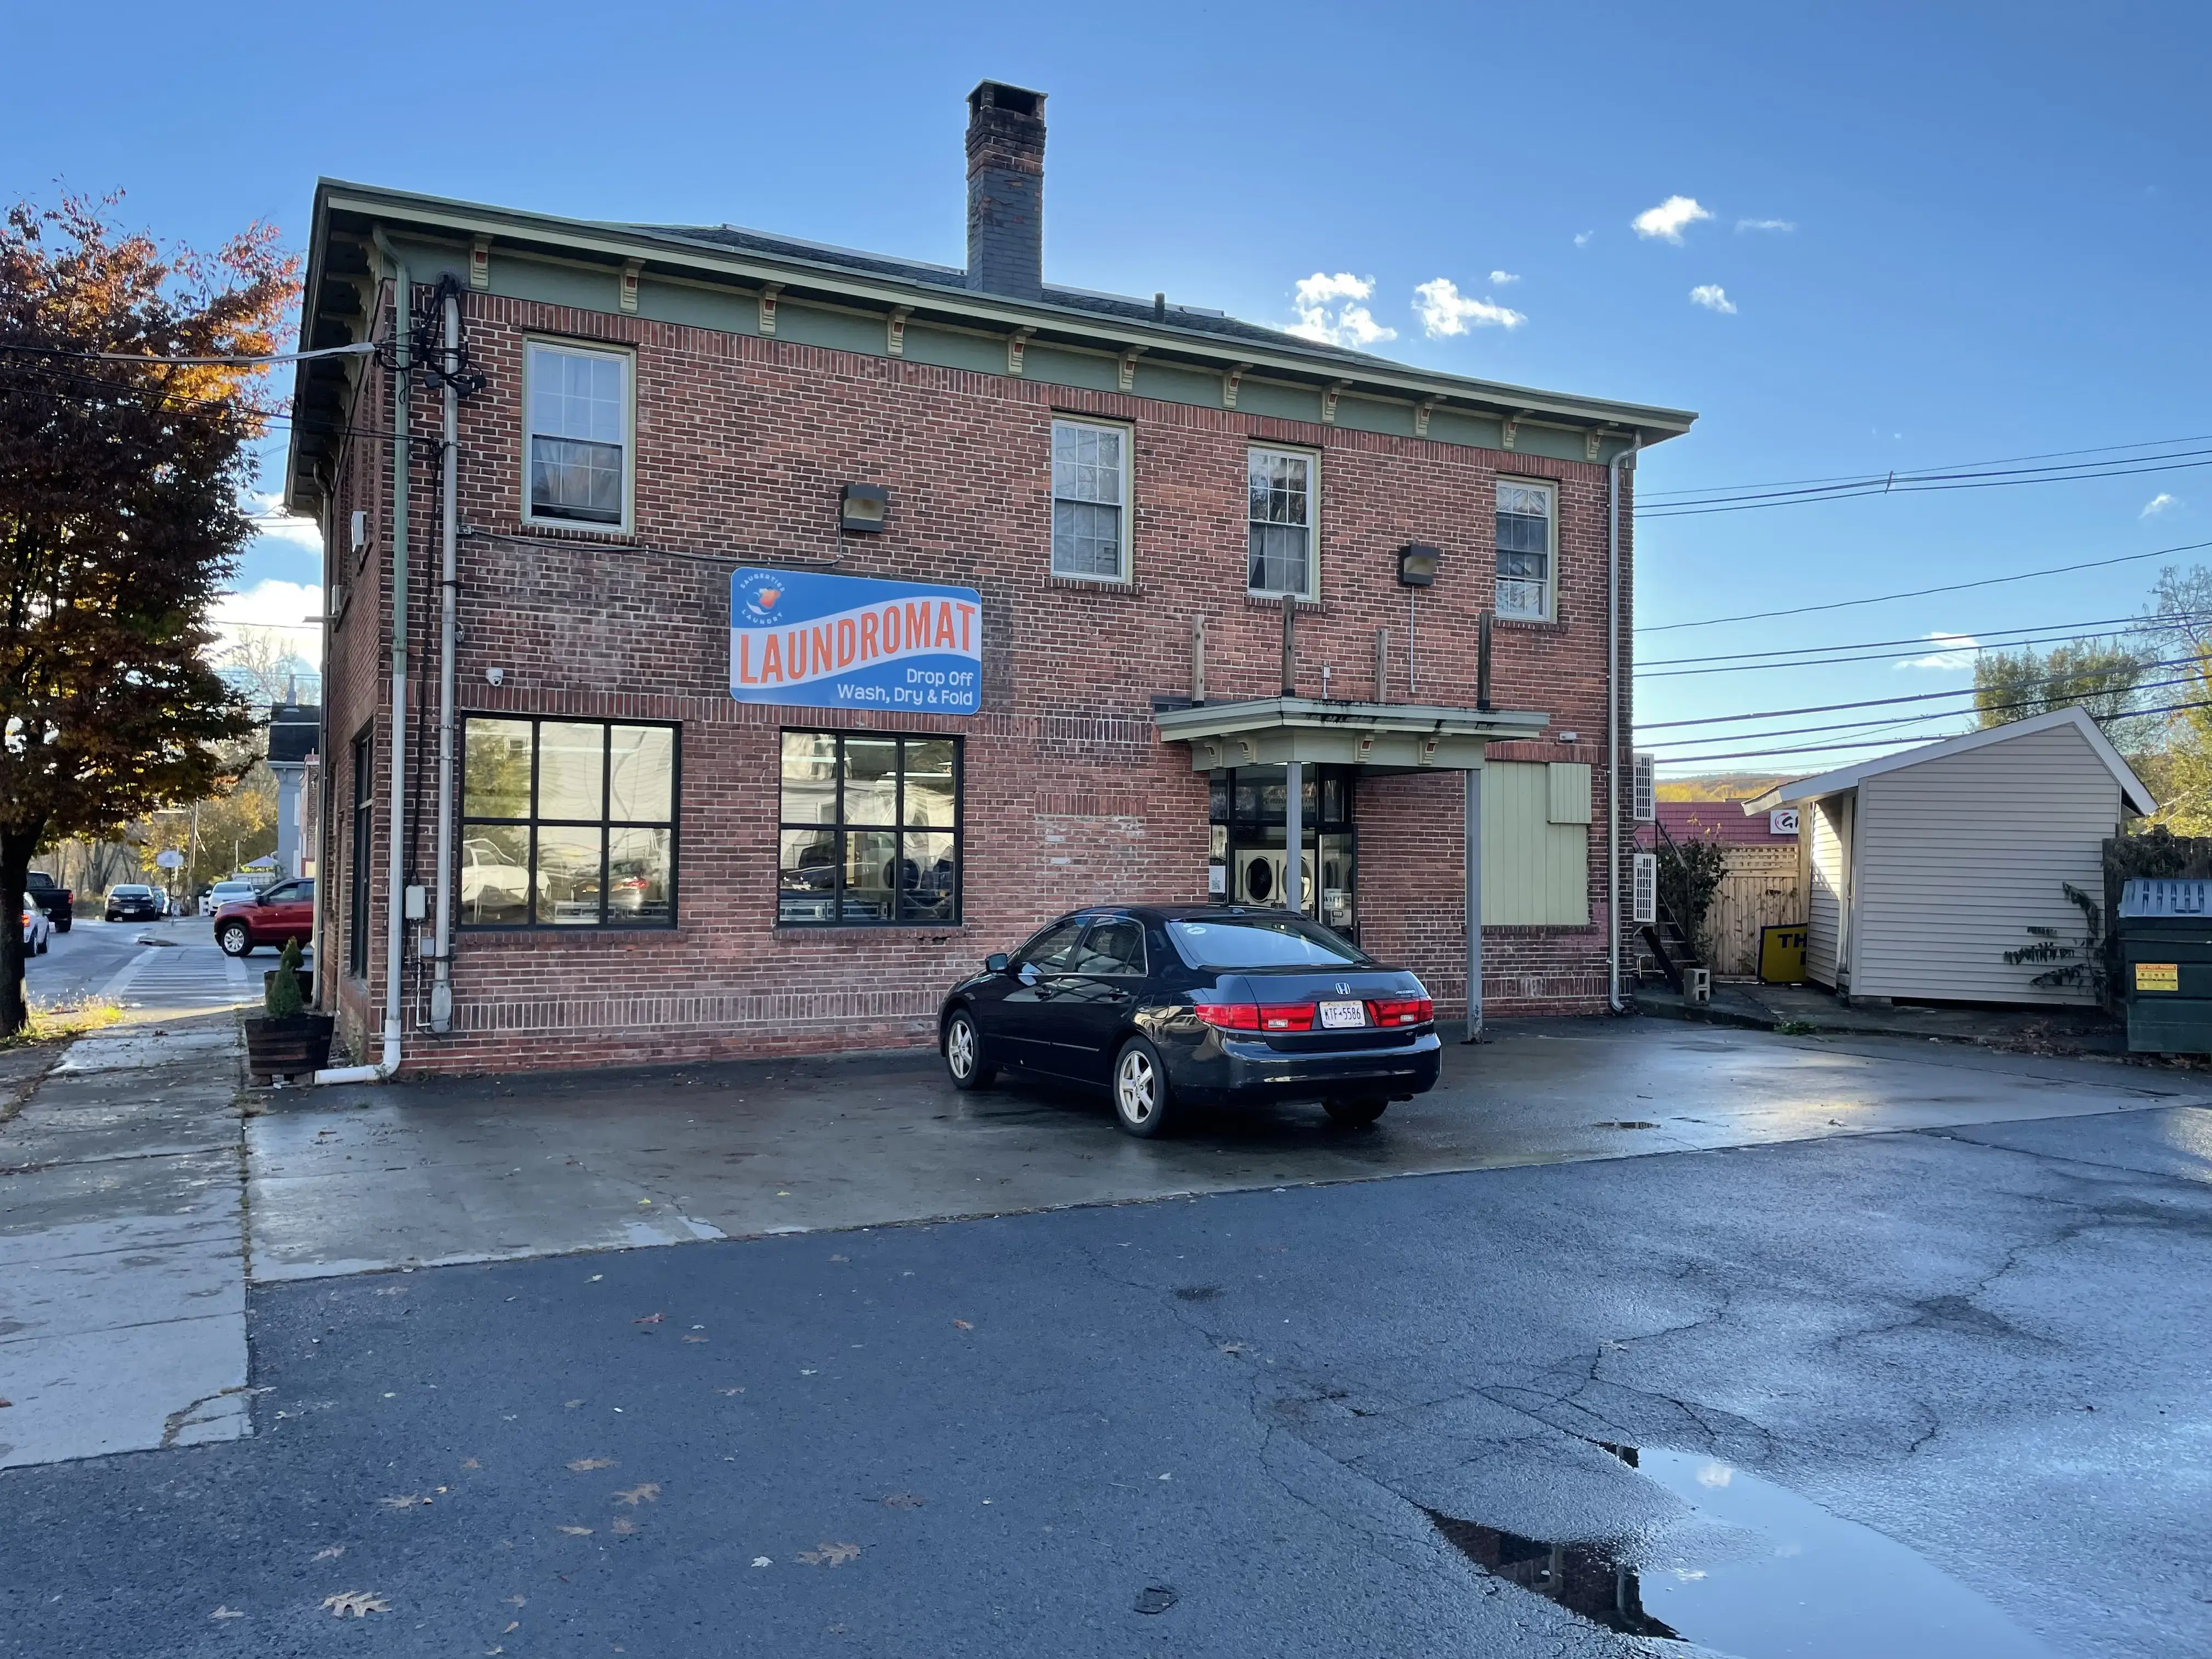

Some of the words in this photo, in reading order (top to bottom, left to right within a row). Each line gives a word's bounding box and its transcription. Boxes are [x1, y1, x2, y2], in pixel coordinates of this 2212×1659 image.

[740, 573, 785, 592] SAUGERTIES
[742, 609, 782, 624] LAUNDRY
[740, 601, 975, 684] LAUNDROMAT
[907, 668, 945, 686] Drop
[949, 671, 974, 686] Off
[837, 684, 890, 703] Wash,
[894, 687, 923, 705] Dry
[927, 689, 938, 704] &
[941, 690, 973, 706] Fold
